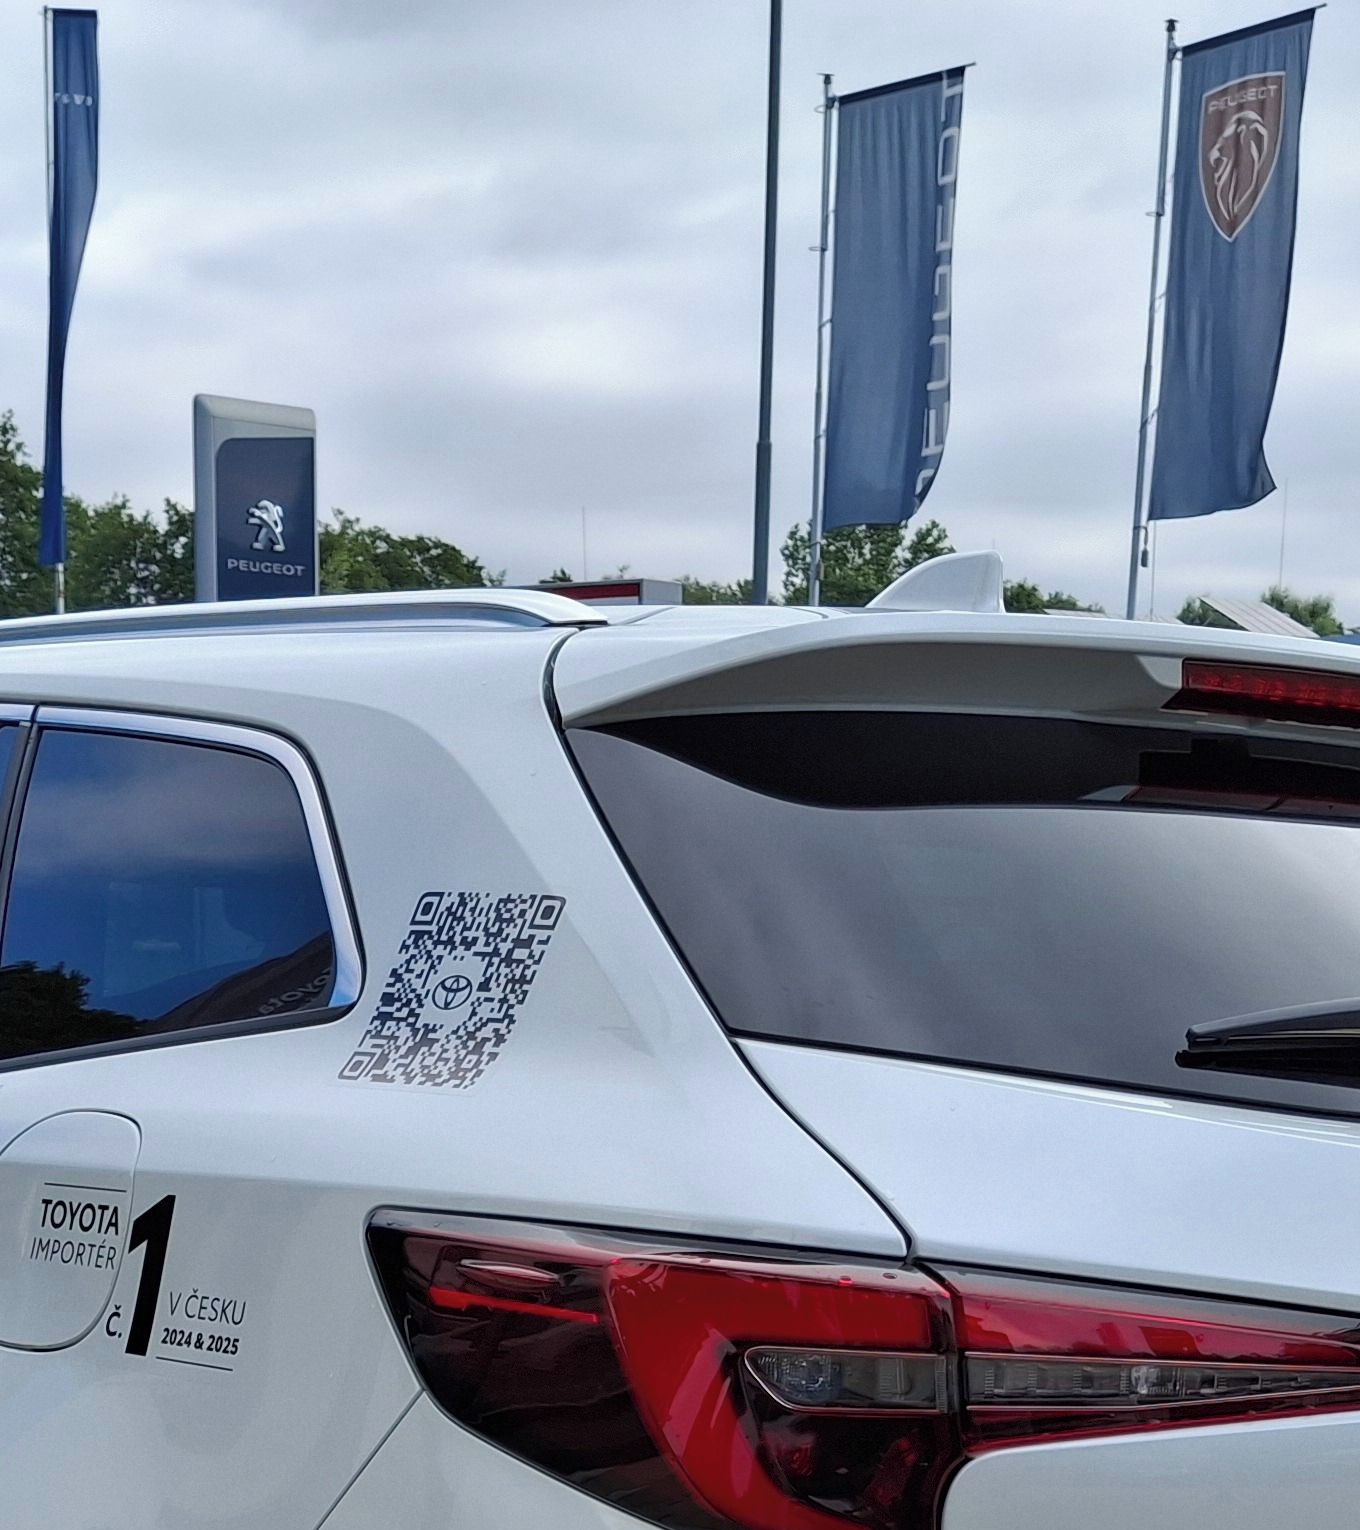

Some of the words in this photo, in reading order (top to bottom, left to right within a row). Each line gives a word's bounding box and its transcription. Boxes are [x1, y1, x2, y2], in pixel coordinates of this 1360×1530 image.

[227, 558, 306, 576] PEUGEOT
[41, 1198, 120, 1236] TOYOTA
[30, 1237, 117, 1270] IMPORTÉR
[105, 1304, 122, 1338] Č.
[125, 1194, 177, 1357] 1
[169, 1291, 182, 1316] V
[185, 1288, 246, 1325] ČESKU
[161, 1328, 192, 1348] 2024
[194, 1333, 205, 1351] &
[206, 1335, 239, 1355] 2025
